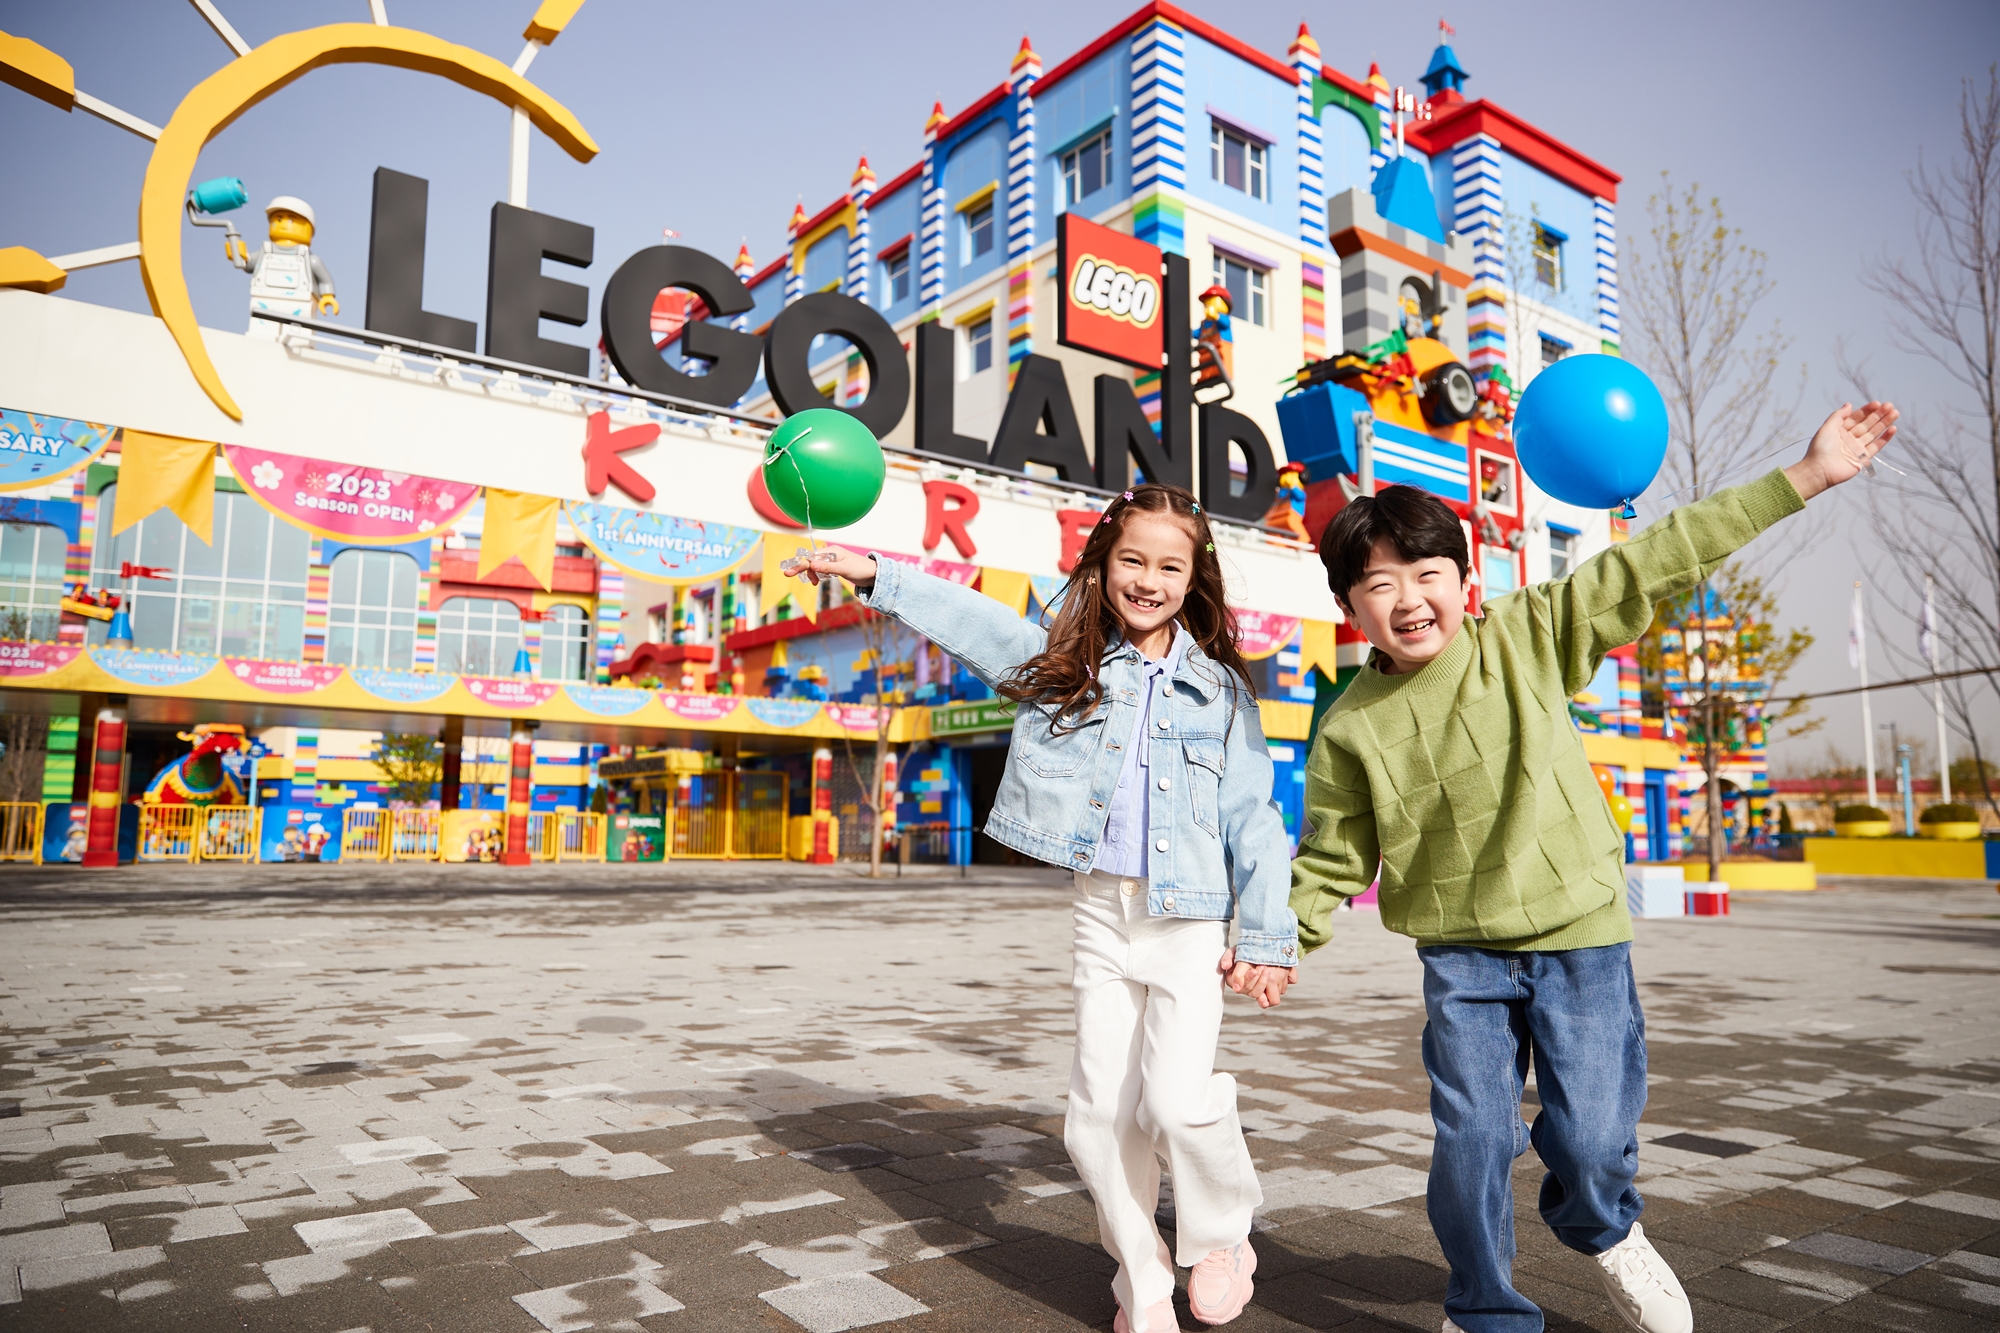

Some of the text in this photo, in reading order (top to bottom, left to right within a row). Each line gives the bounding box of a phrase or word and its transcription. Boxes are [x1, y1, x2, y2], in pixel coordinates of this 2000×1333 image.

[1074, 259, 1156, 323] LEGO
[365, 166, 1277, 523] LEGOLAND
[325, 472, 391, 501] 2023
[294, 492, 415, 523] Season OPEN
[596, 523, 733, 559] 1st ANNIVERSARY
[0, 645, 30, 659] 023
[126, 660, 200, 675] ANNIVERSARY
[269, 665, 301, 678] 2023
